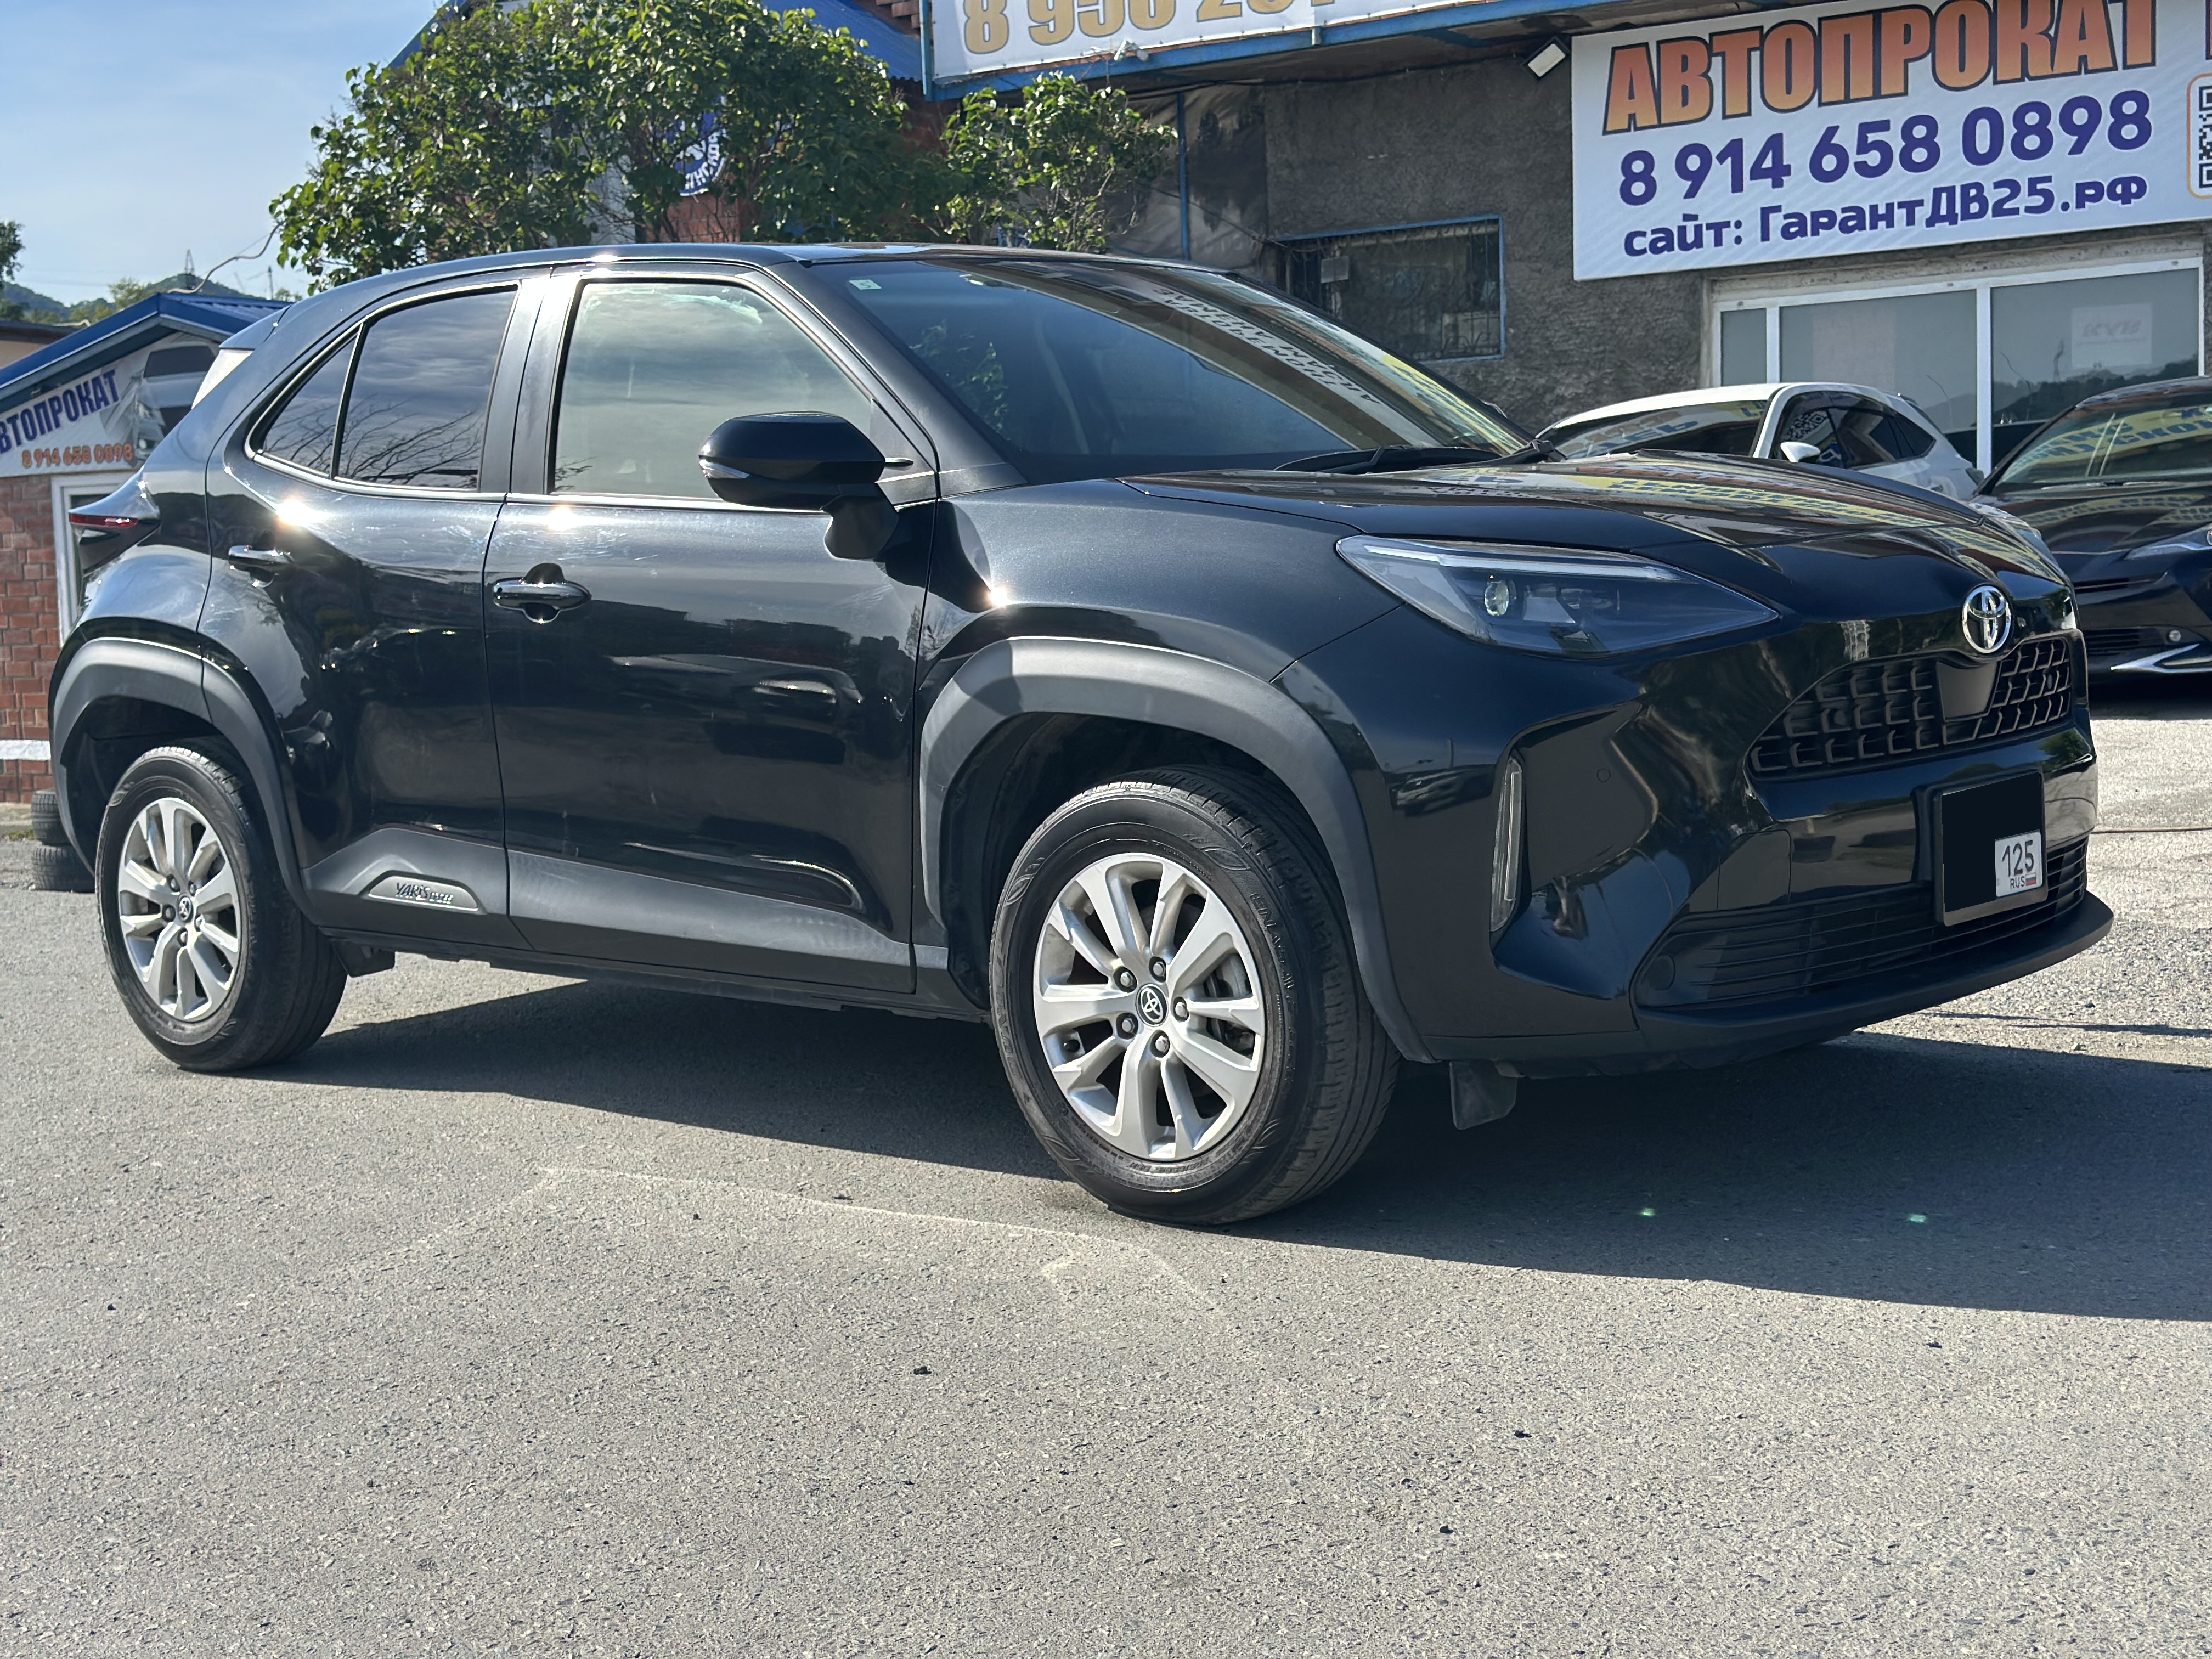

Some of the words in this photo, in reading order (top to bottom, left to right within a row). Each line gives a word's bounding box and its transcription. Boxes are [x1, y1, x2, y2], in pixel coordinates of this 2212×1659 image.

[963, 0, 1009, 54] 8
[1602, 0, 2156, 135] АВТОПРОКАТ
[1619, 150, 1657, 206] 8
[1674, 133, 1791, 200] 914
[1809, 114, 1941, 184] 658
[1961, 89, 2152, 166] 0898
[1623, 212, 1743, 257] сайт:
[0, 369, 119, 454] ВТОПРОКАТ
[22, 449, 32, 469] 8
[34, 448, 61, 467] 914
[63, 445, 92, 466] 658
[94, 443, 134, 463] 0898
[2002, 840, 2034, 877] 125
[396, 882, 430, 900] YARIS
[2010, 877, 2025, 889] RUS
